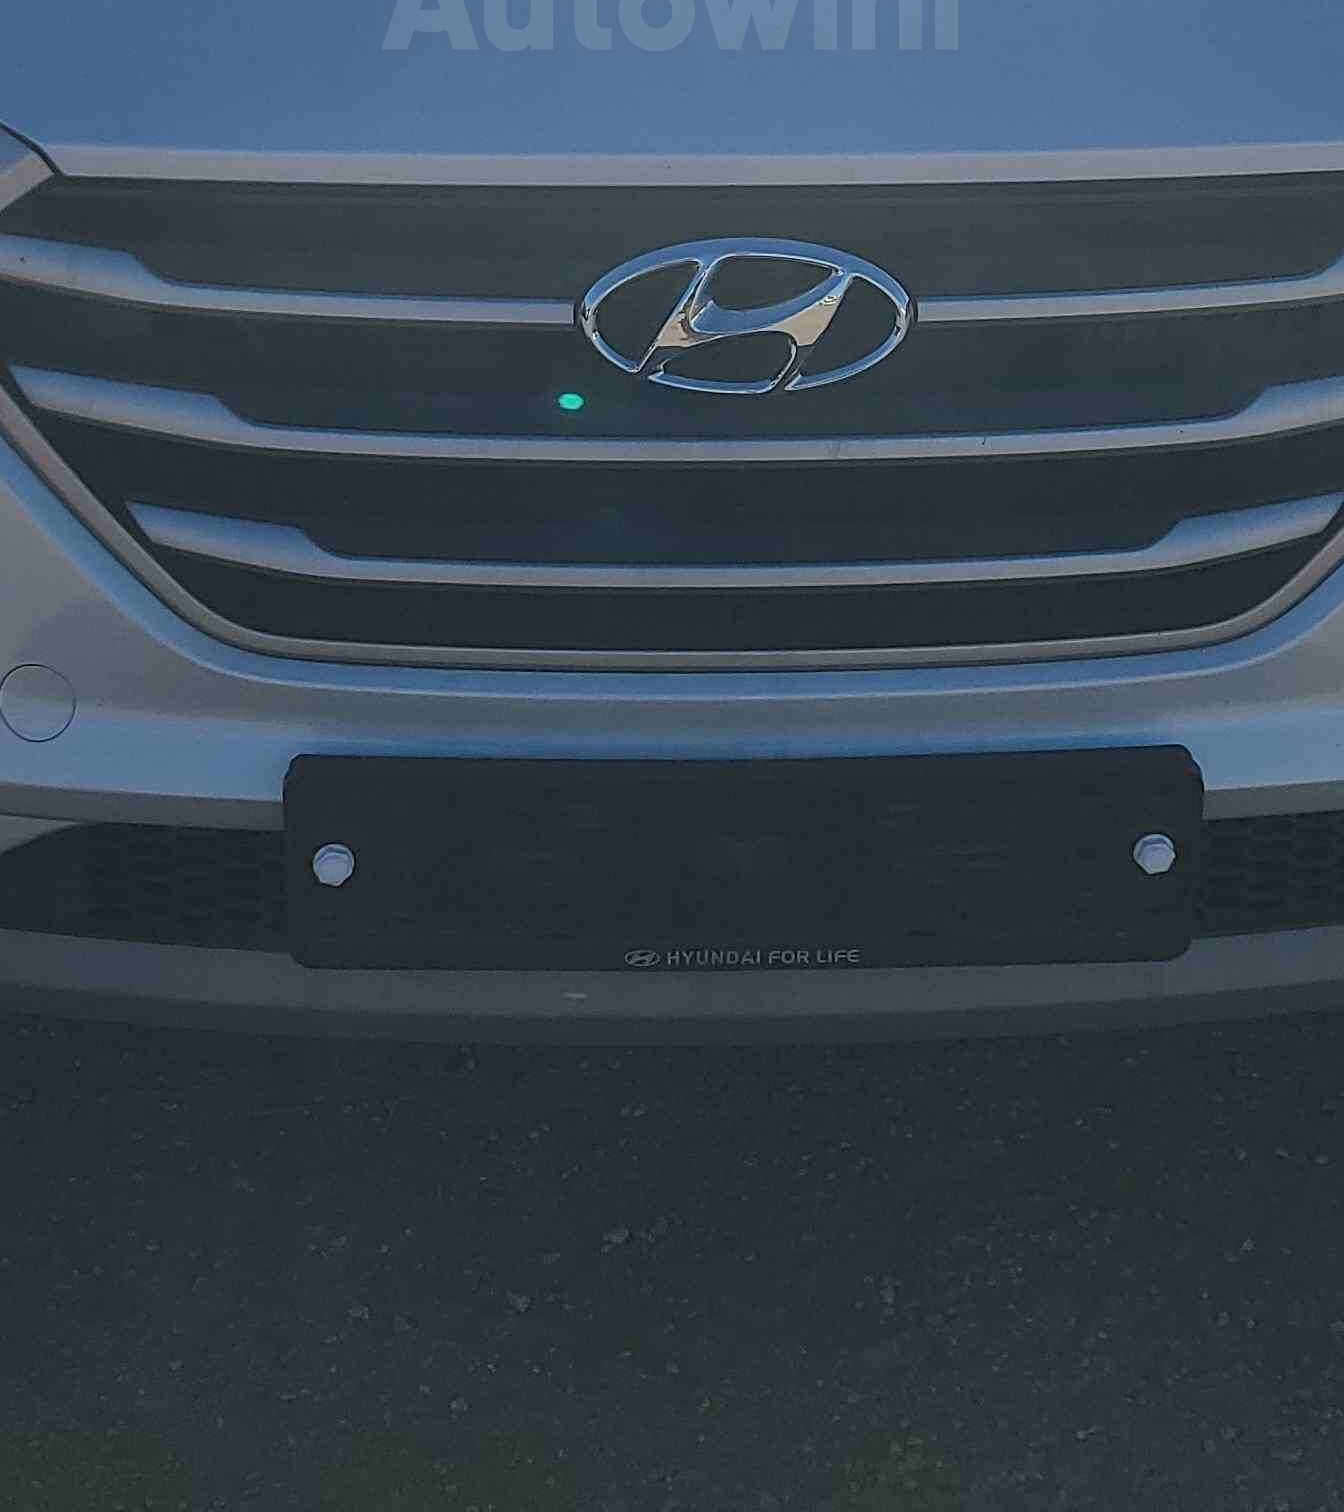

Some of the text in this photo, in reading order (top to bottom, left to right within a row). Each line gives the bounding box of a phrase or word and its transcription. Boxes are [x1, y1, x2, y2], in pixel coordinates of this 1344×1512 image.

[666, 948, 861, 966] HYUNDAI FOR LIFE
